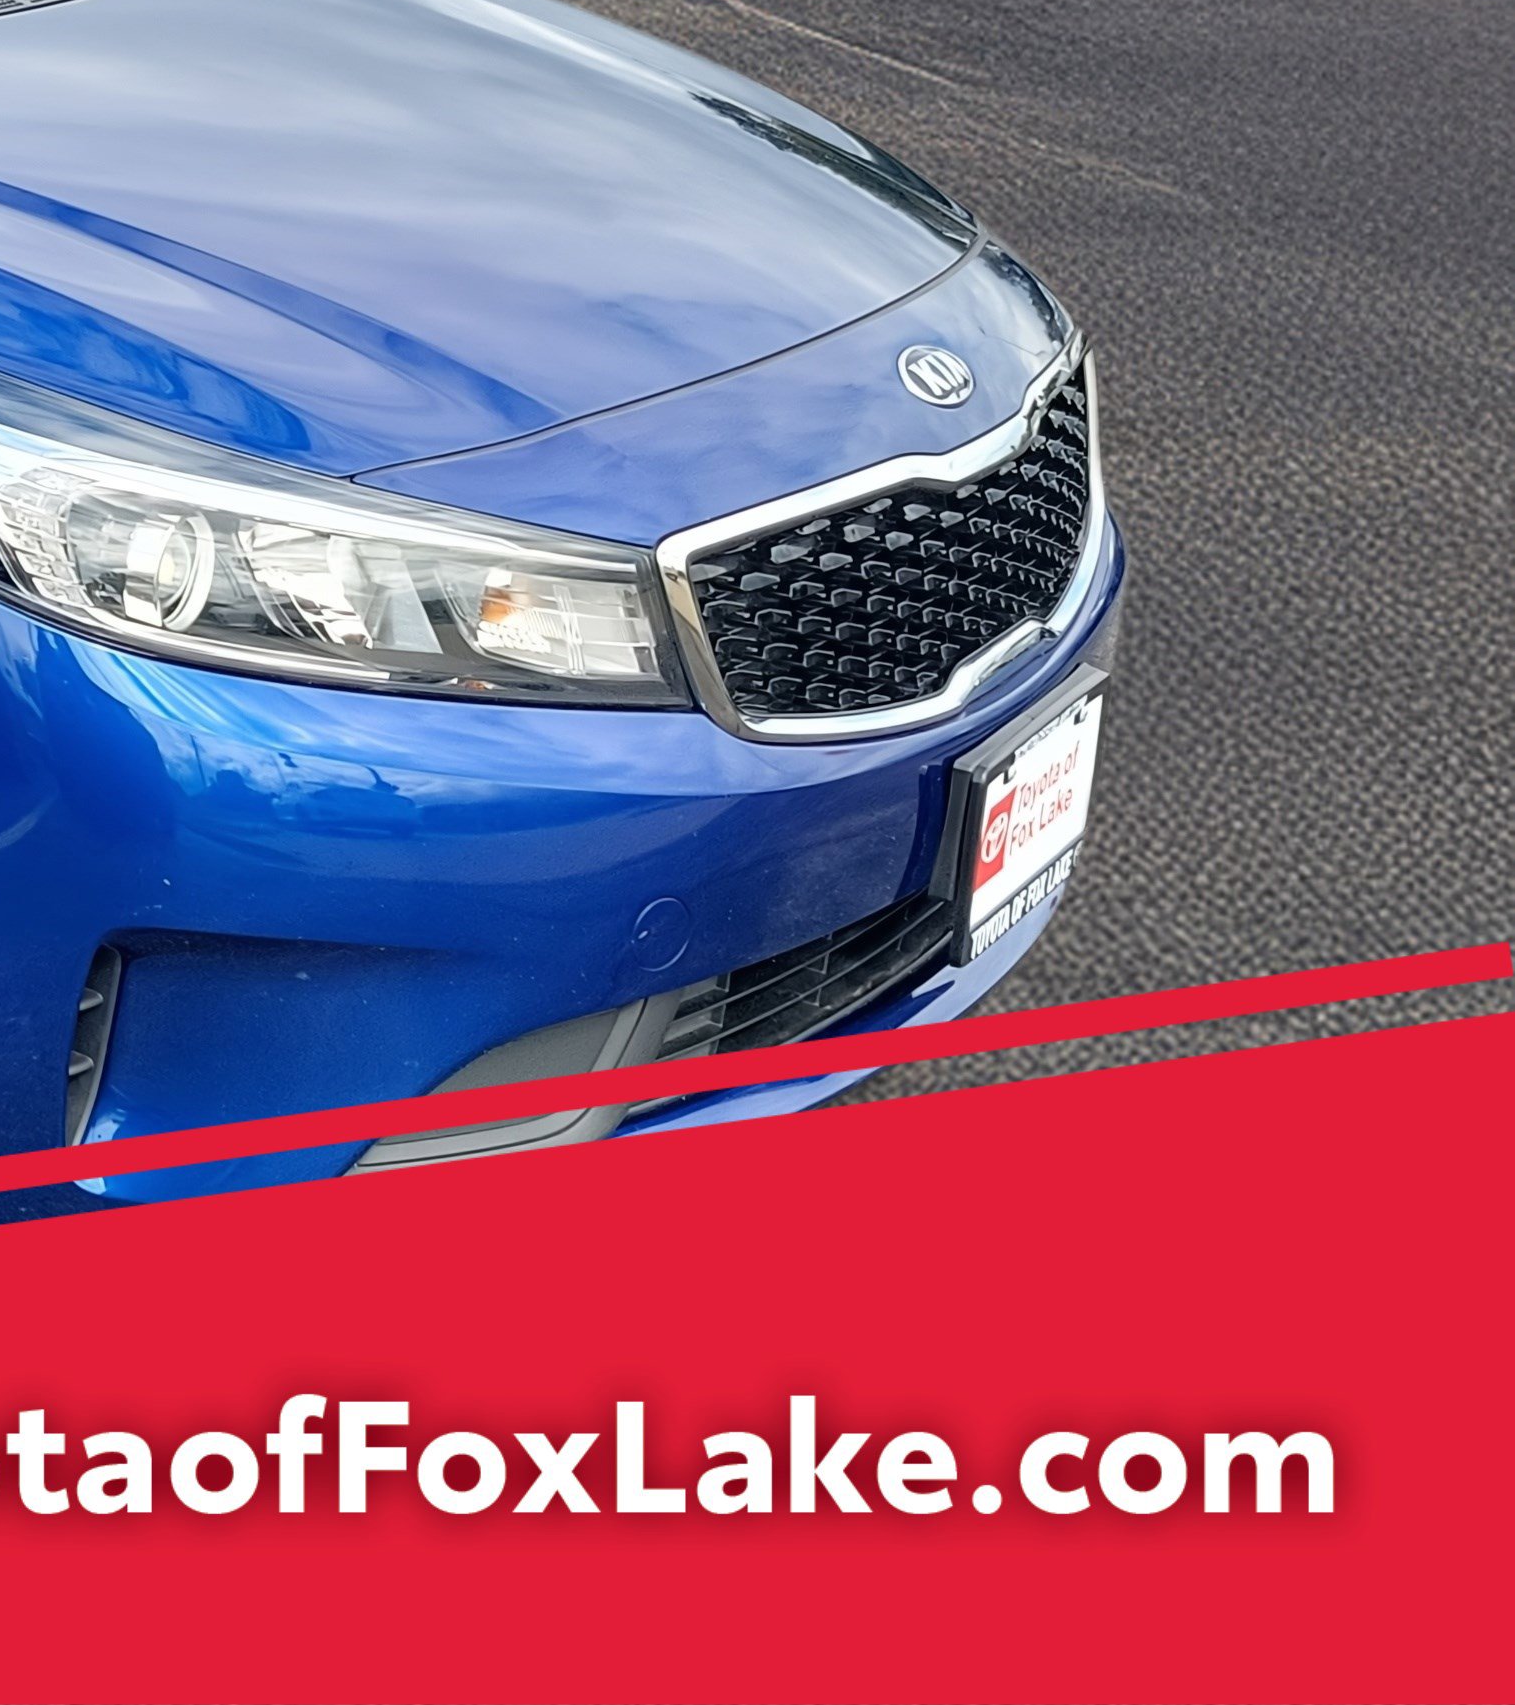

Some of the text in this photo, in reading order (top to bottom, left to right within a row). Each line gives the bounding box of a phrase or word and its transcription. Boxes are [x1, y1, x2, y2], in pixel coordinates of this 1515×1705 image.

[907, 350, 970, 398] KIA
[1017, 739, 1081, 813] Toyota of
[1009, 816, 1036, 856] Fox
[1038, 788, 1073, 822] Lake
[970, 903, 1011, 960] TOYOTA
